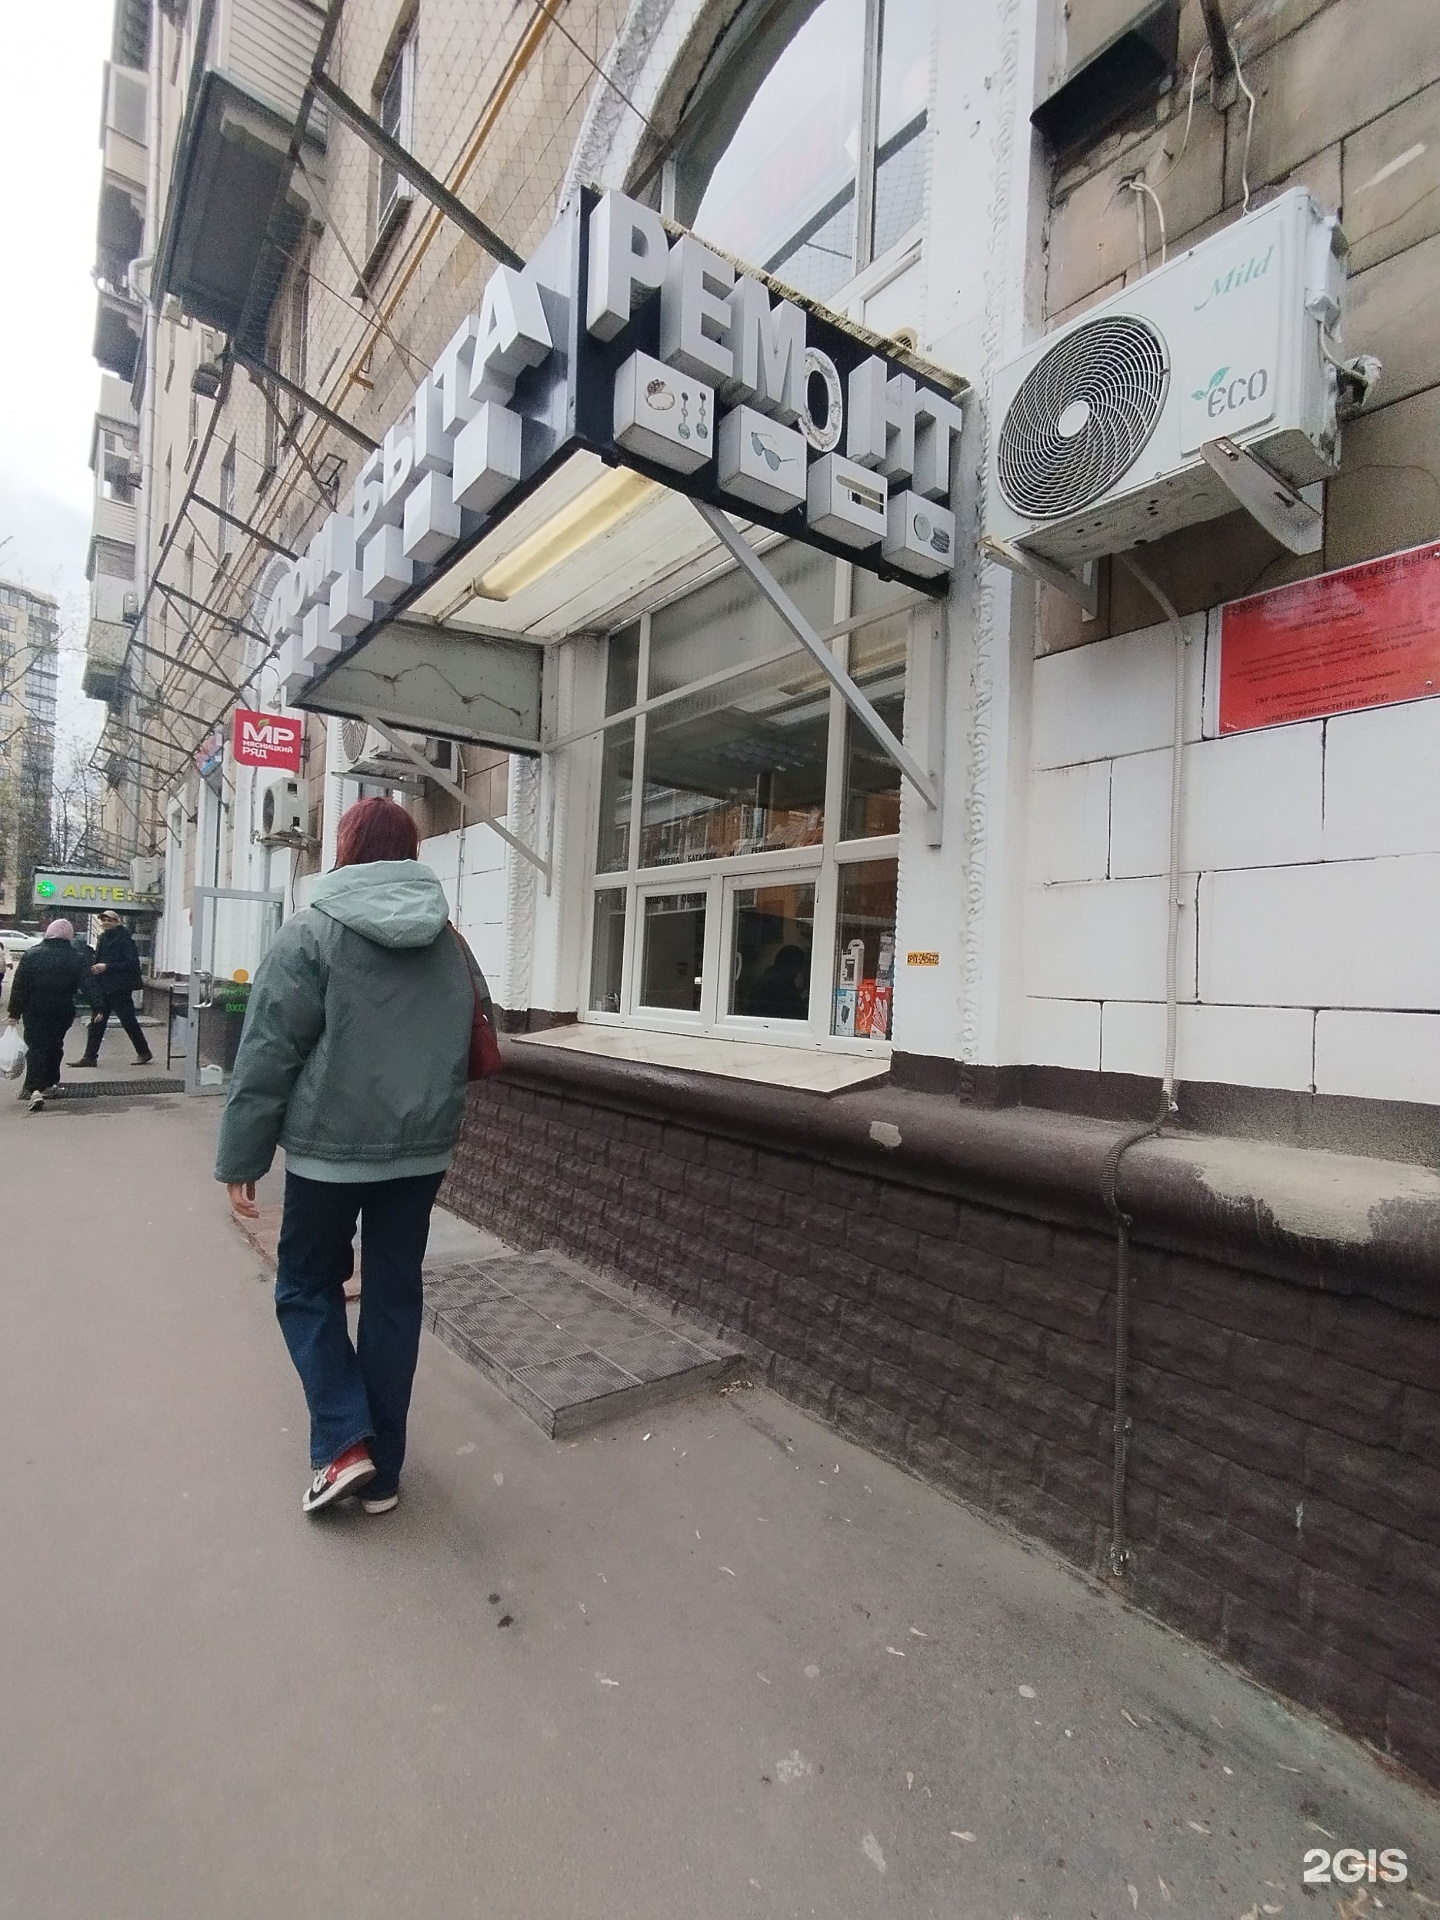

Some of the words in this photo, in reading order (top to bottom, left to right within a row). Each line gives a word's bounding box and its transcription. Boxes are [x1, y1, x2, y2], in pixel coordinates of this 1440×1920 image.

[1194, 244, 1274, 312] Mild
[587, 189, 962, 499] РЕМОНТ
[355, 263, 552, 543] БЫТА
[242, 740, 293, 754] МЯСНИЦКИЙ
[242, 746, 267, 760] РЯД
[63, 883, 156, 904] АПТЕК
[225, 1003, 246, 1013] ВХО
